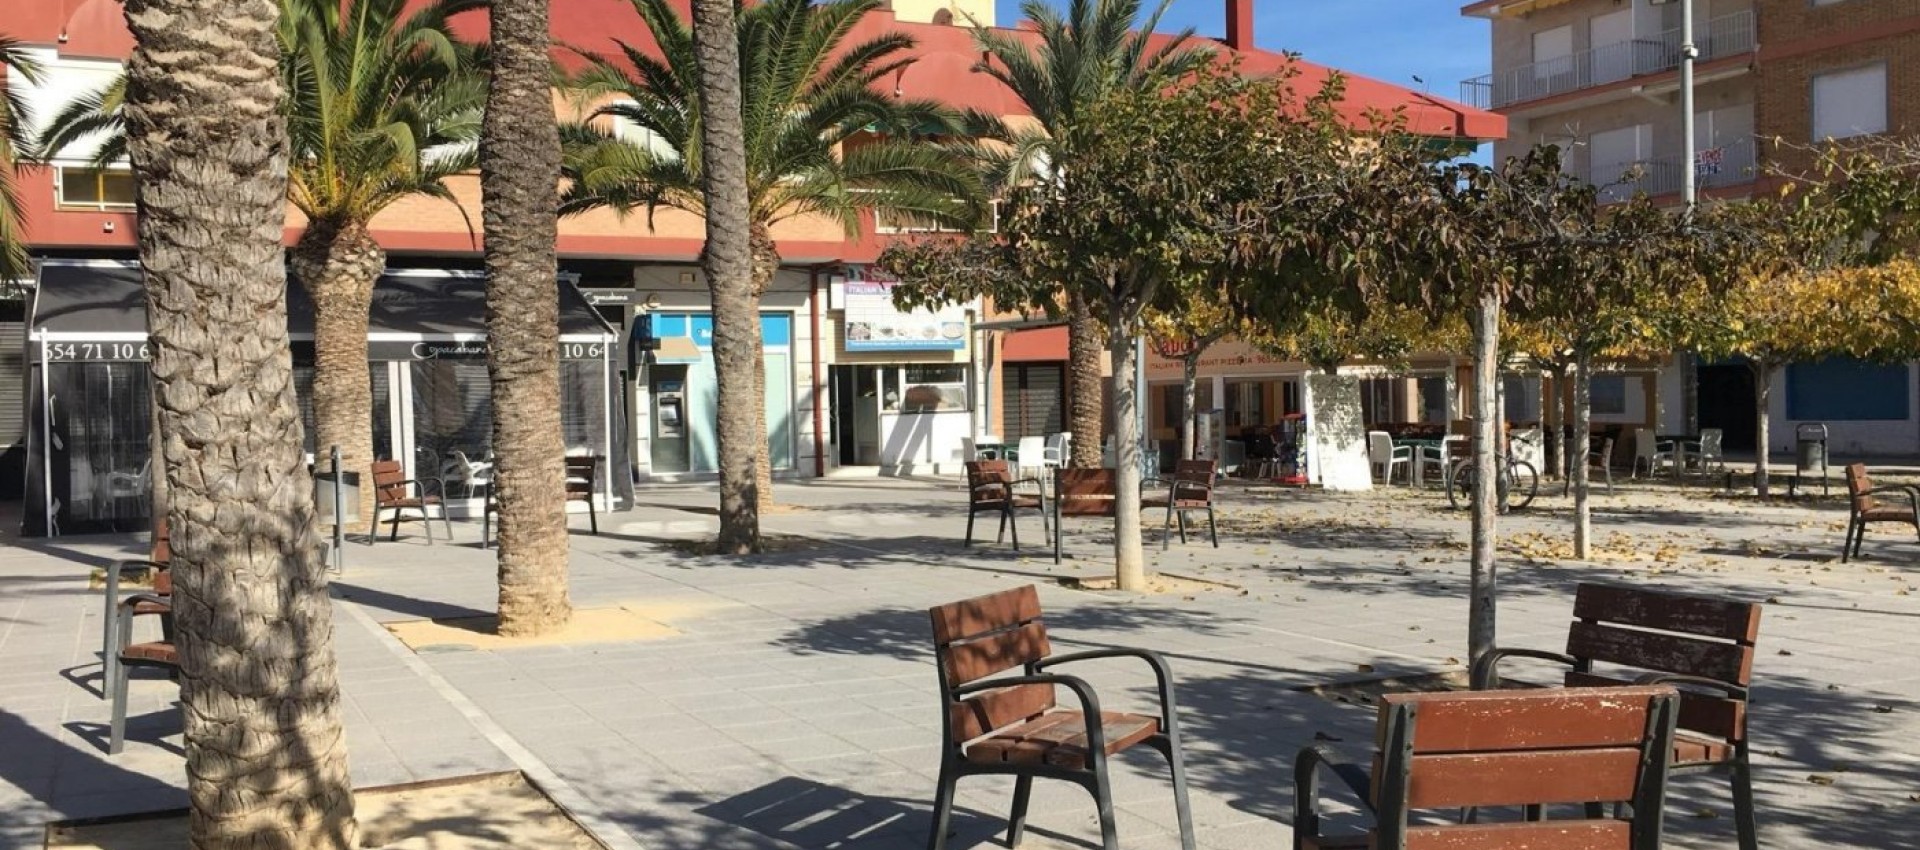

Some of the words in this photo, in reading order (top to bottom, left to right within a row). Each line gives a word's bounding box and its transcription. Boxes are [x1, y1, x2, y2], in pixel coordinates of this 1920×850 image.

[82, 343, 103, 359] 71
[112, 343, 133, 359] 10
[139, 343, 150, 359] 6
[564, 343, 583, 359] 10
